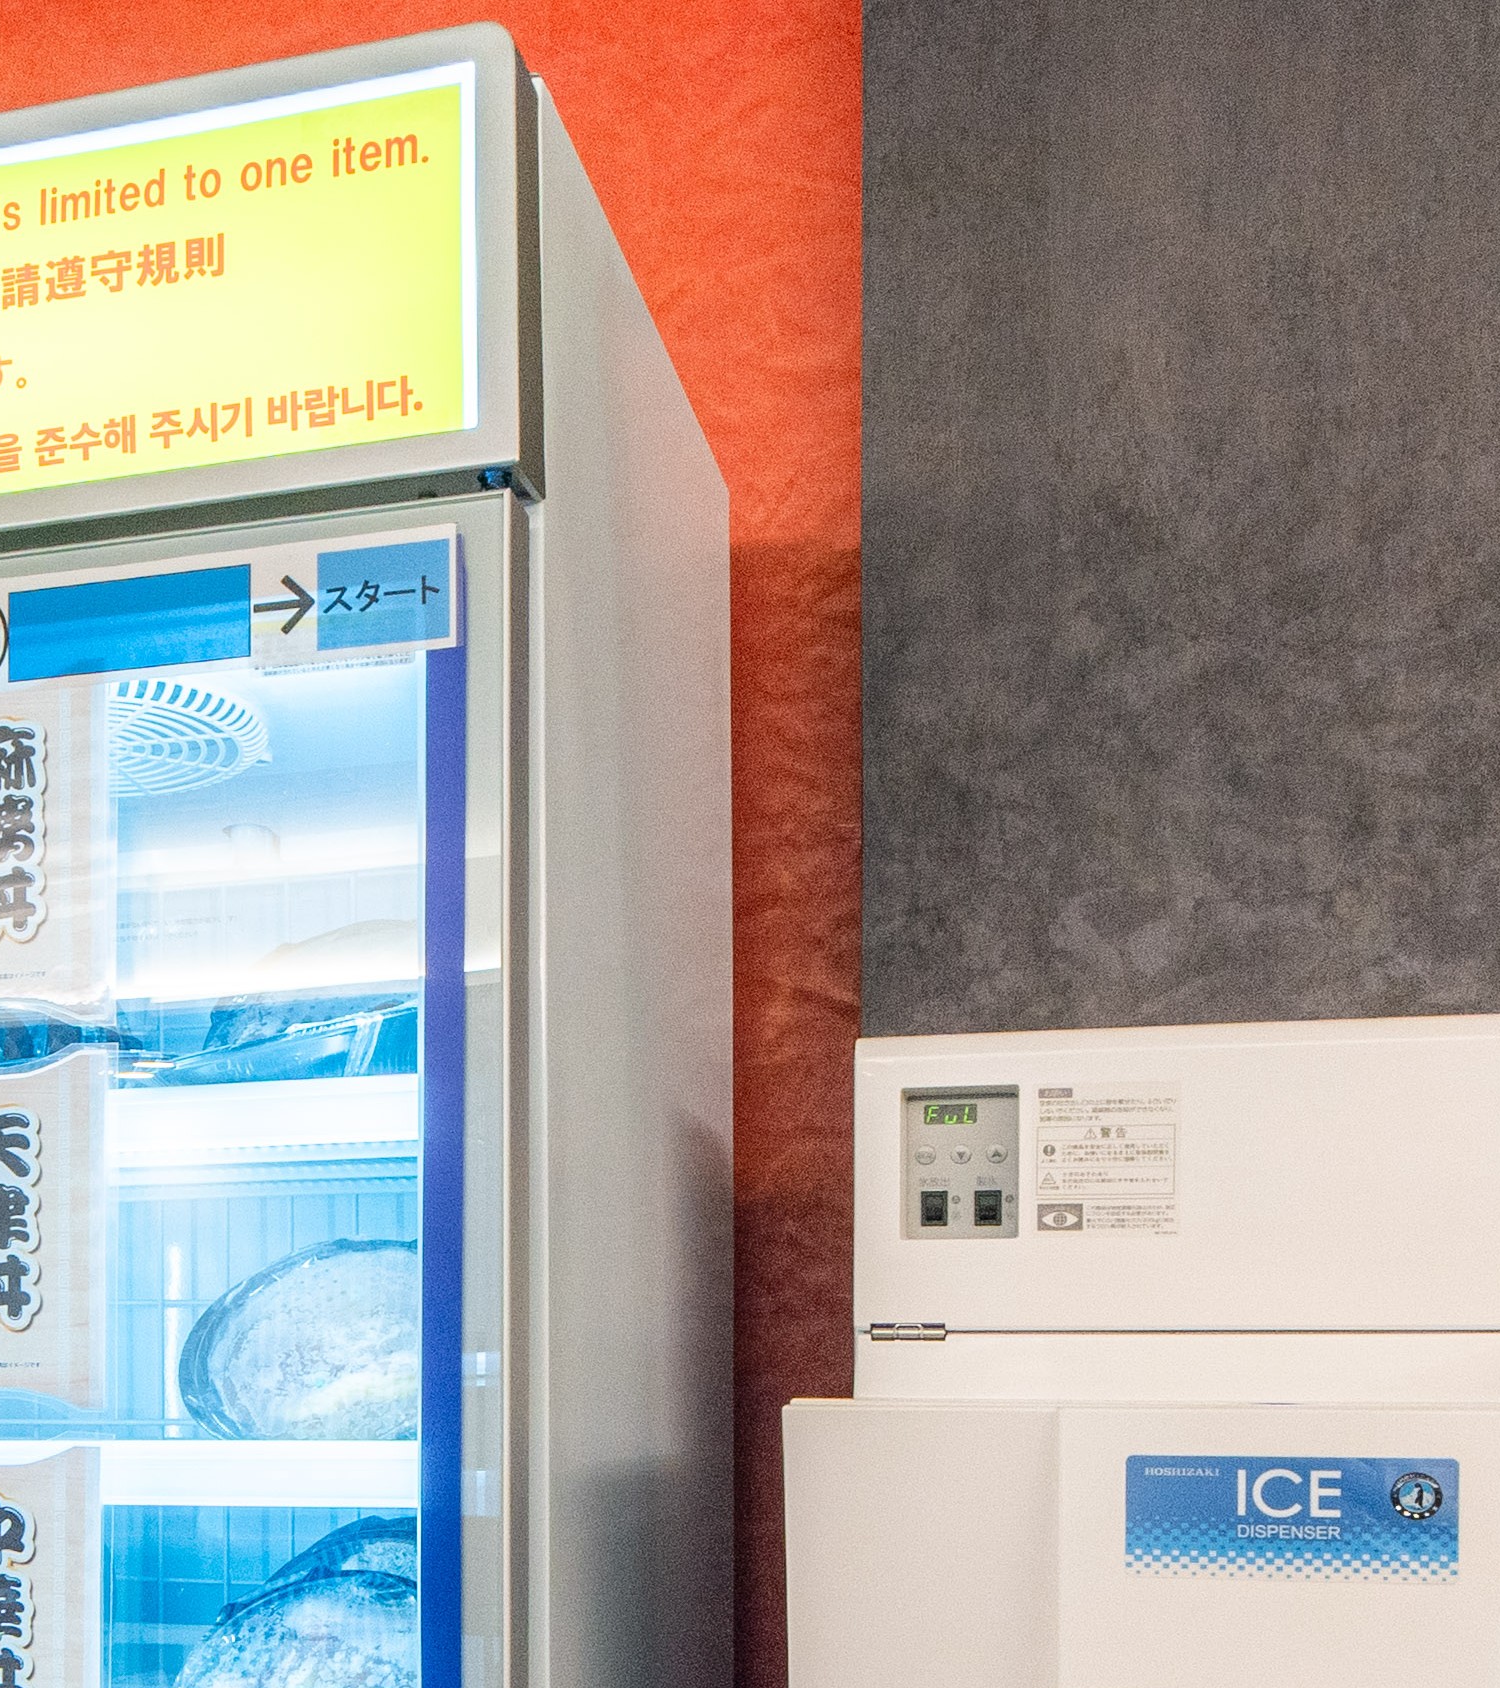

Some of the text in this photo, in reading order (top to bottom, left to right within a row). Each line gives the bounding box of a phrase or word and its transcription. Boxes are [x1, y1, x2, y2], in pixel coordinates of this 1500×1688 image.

[41, 169, 167, 227] limited
[184, 165, 223, 202] to
[241, 154, 314, 193] one
[333, 134, 430, 179] item.
[35, 415, 138, 468] 준수해
[150, 398, 254, 450] 주시기
[268, 376, 424, 432] 바랍니다.
[322, 575, 441, 613] スタート
[1144, 1466, 1220, 1478] HOSHIZAKI
[1237, 1469, 1342, 1518] ICE
[1237, 1523, 1341, 1540] DISPENSER
